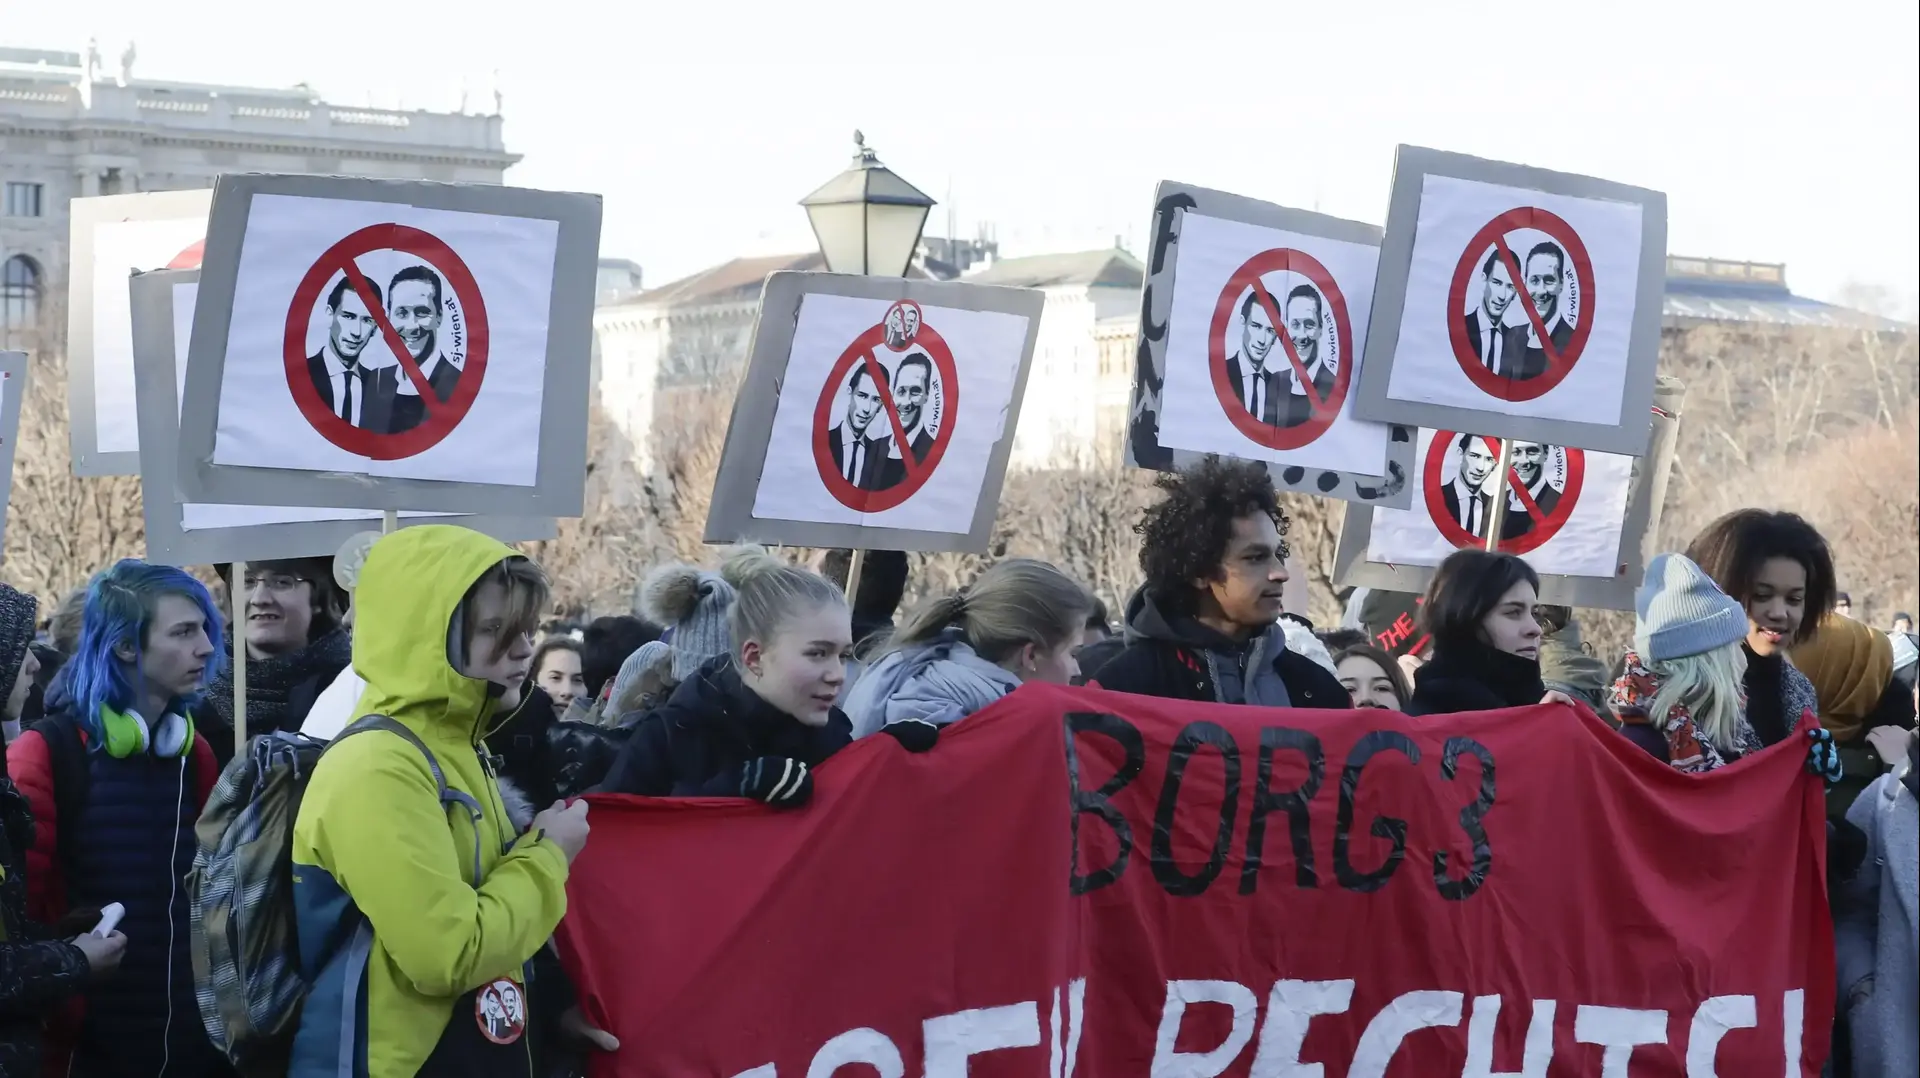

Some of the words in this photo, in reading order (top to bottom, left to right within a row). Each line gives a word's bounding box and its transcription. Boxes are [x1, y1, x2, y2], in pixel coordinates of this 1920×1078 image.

[1565, 268, 1577, 323] sj-wien.at
[444, 297, 464, 363] sj-wien.at
[1324, 312, 1337, 368] sj-wien.at
[929, 379, 941, 433] sj-wien.at
[1553, 445, 1564, 487] sj-wien.a
[1376, 611, 1417, 651] THE
[1063, 712, 1421, 896] BORG
[1433, 737, 1496, 900] 3
